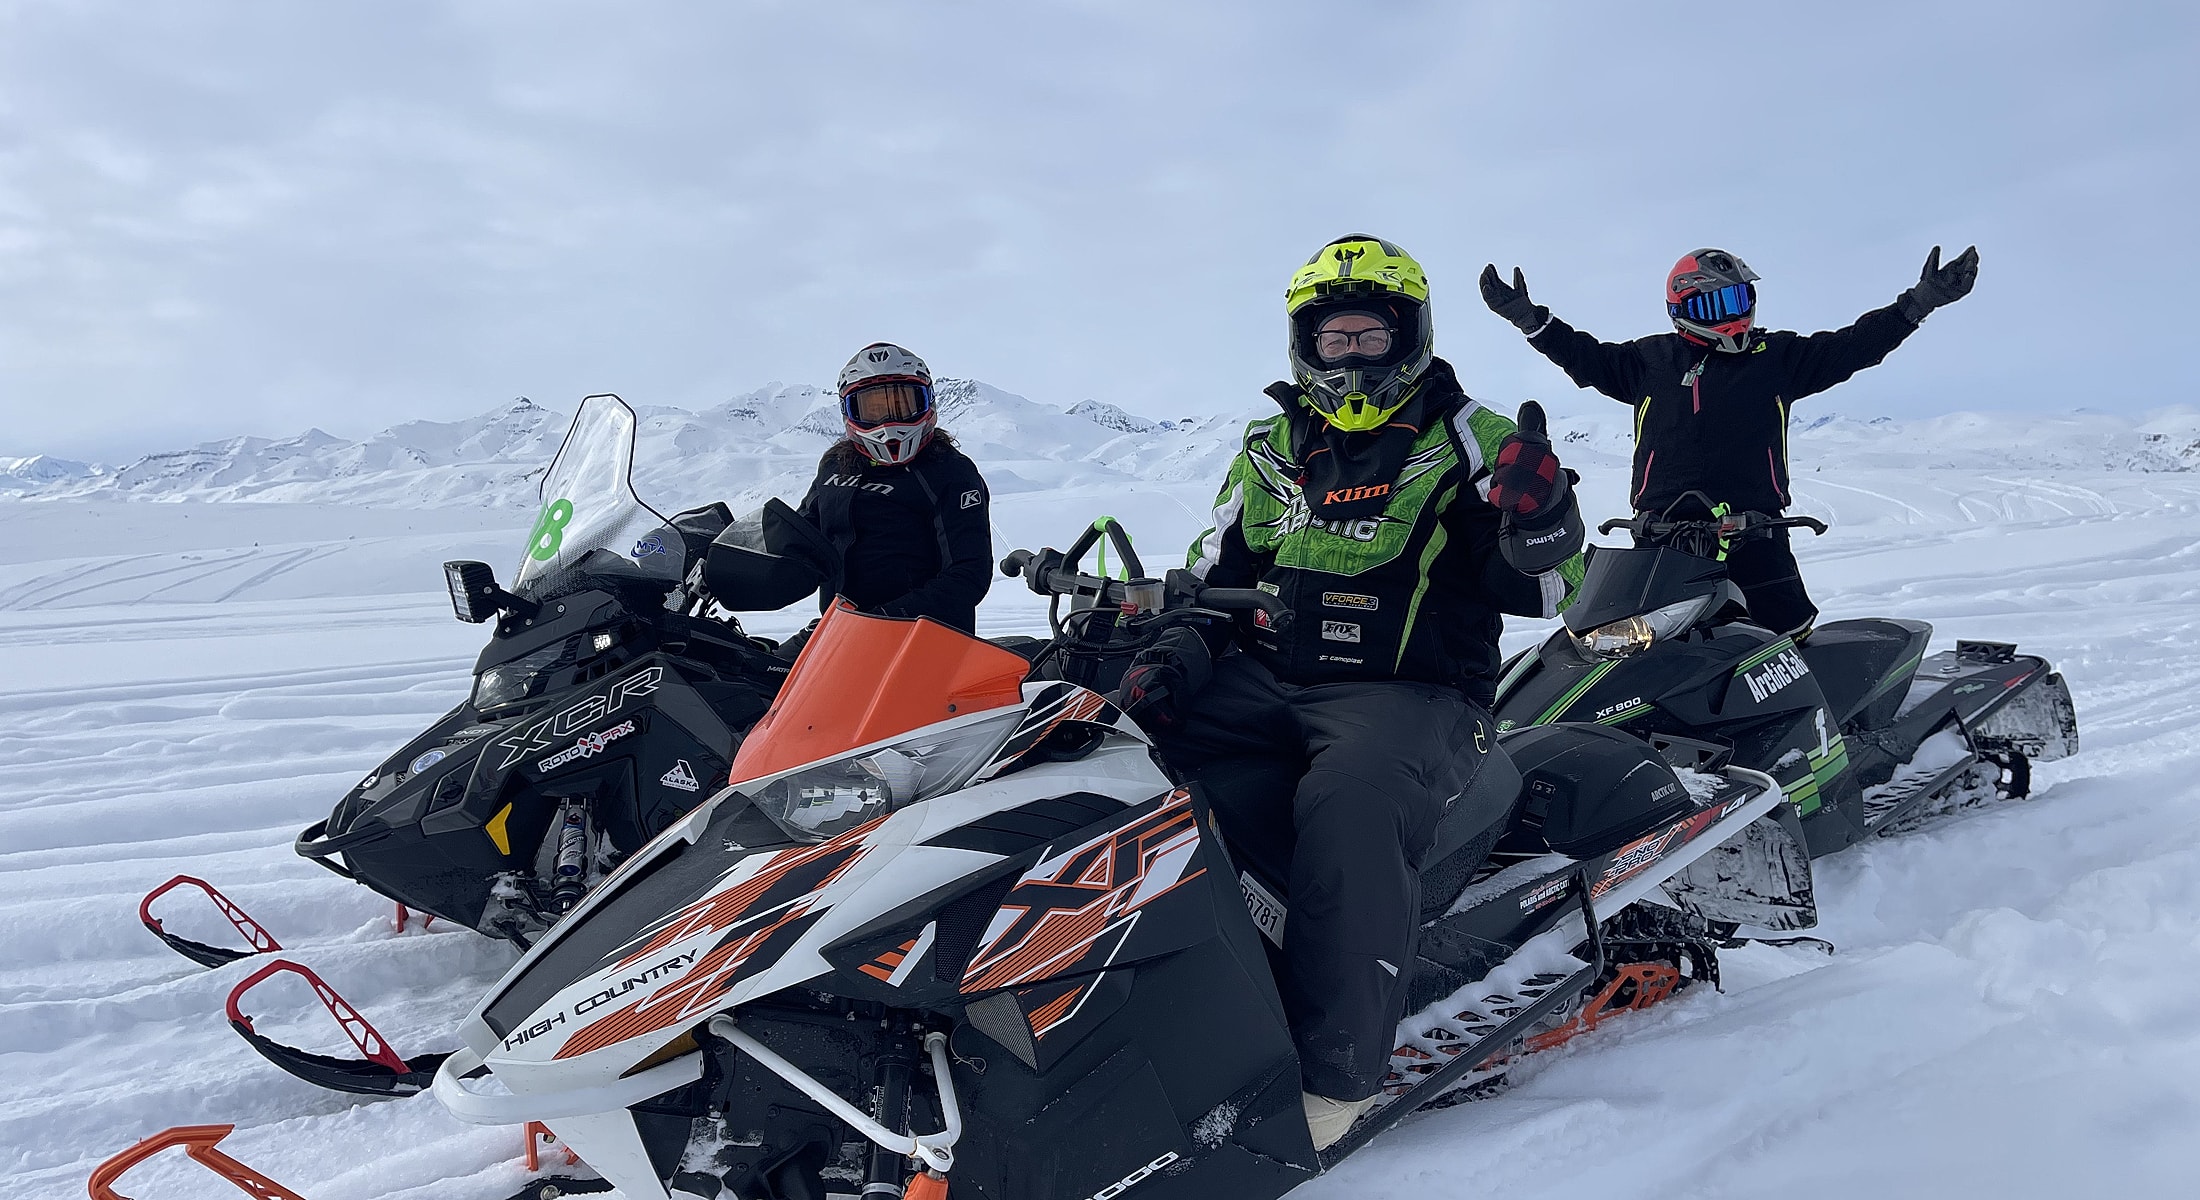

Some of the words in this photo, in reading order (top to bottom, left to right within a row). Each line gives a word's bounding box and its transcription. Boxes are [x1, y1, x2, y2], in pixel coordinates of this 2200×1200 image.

[636, 540, 666, 555] MTA
[1526, 527, 1567, 547] Eskimo
[1323, 623, 1359, 640] FOX
[1744, 661, 1793, 704] Arctic
[497, 666, 663, 771] XCR
[1596, 706, 1614, 719] XF
[1615, 697, 1641, 712] 800
[662, 775, 698, 788] ALASKA
[1650, 785, 1669, 802] ARCTIC
[1721, 793, 1747, 818] 141
[1610, 851, 1654, 876] PRO
[1616, 840, 1660, 866] SNO
[503, 1011, 566, 1052] HIGH
[573, 947, 698, 1017] COUNTRY
